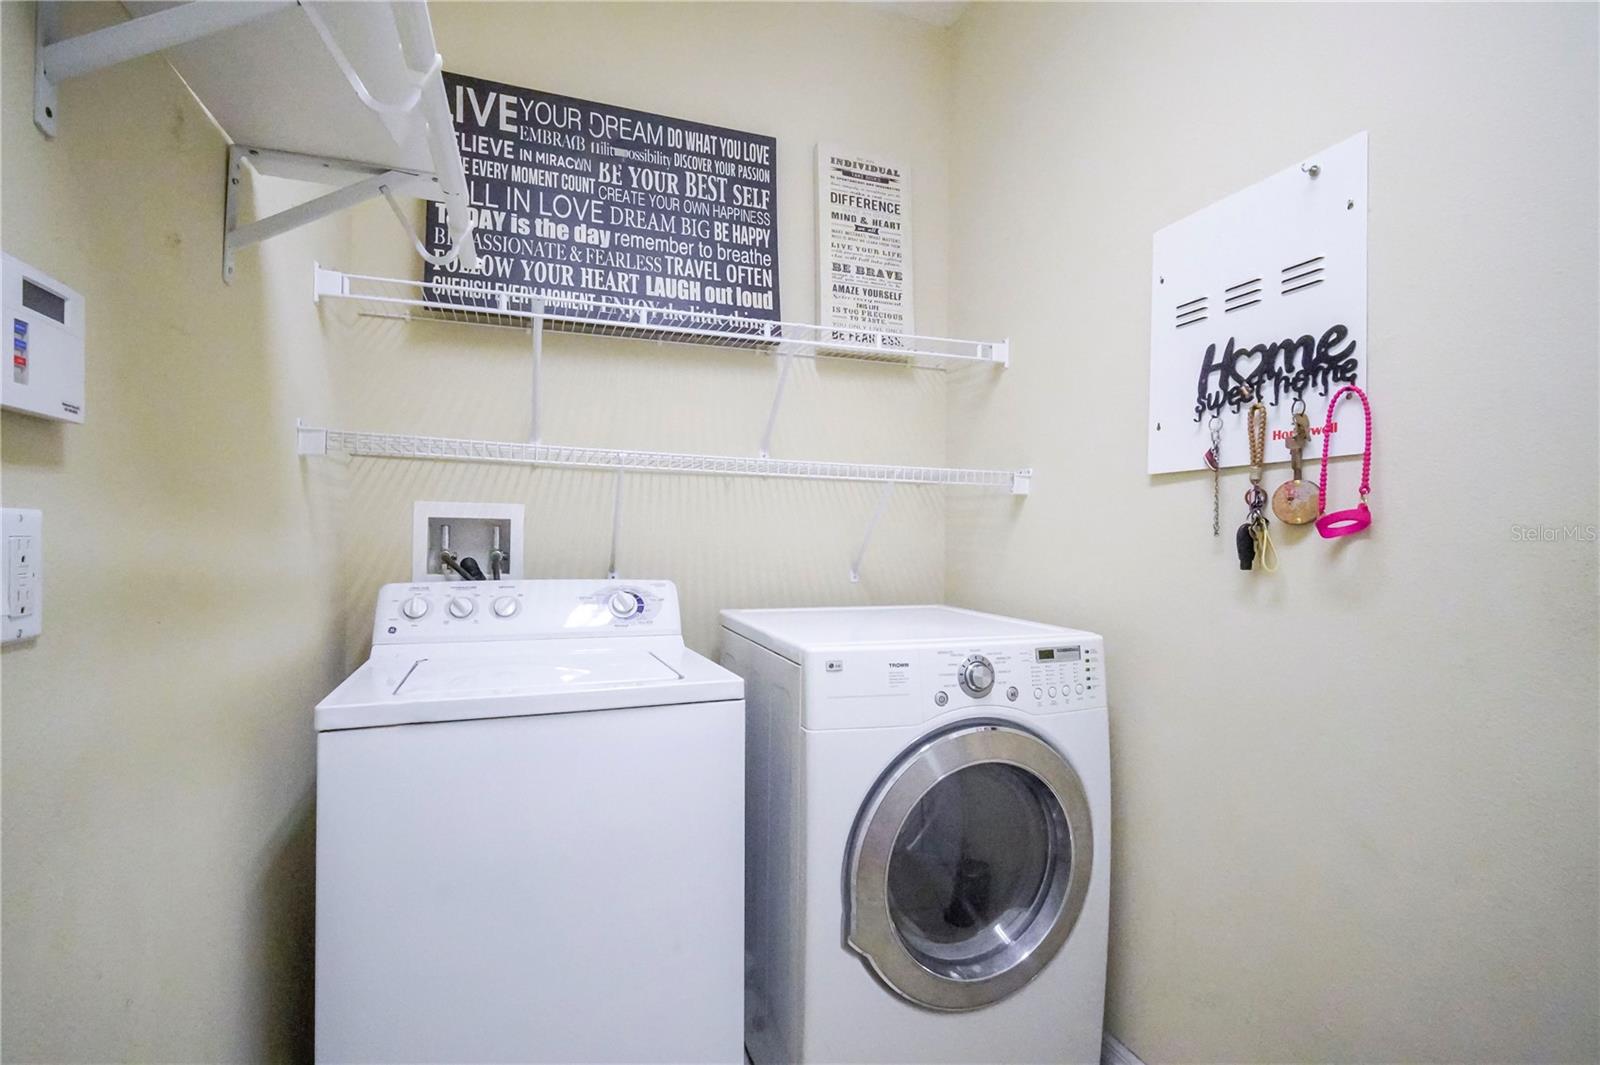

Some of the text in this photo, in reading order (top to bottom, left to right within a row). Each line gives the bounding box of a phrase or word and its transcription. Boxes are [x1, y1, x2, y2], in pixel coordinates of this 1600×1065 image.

[455, 85, 771, 166] IVE YOUR DREAM DO WHAT YOU LOVE
[519, 148, 532, 162] IN
[673, 152, 713, 174] DISCOVER
[714, 159, 736, 178] YOUR
[737, 165, 771, 184] PASSION
[830, 156, 901, 177] INDIVIDUAL
[472, 158, 508, 180] EVERY
[511, 165, 560, 188] MOMENT
[561, 173, 596, 195] COUNT
[598, 162, 771, 210] BE YOUR BEST SELF
[470, 180, 771, 249] LL IN LOVE DREAM BIG BE HAPPY
[598, 186, 771, 227] CREATE YOUR OWN HAPPINESS
[830, 192, 901, 215] DIFFERENCE
[435, 202, 772, 267] TDAY is the day remember to breathe
[831, 212, 857, 223] MIND
[860, 217, 869, 225] &
[872, 219, 901, 231] HEART
[473, 232, 568, 262] ASSIONATE
[569, 246, 584, 263] &
[586, 247, 663, 274] FEARLESS
[664, 255, 722, 282] TRAVEL
[725, 263, 773, 288] OFTEN
[831, 242, 853, 251] LIVE
[855, 246, 880, 256] YOUR
[882, 250, 902, 259] LIFE
[520, 259, 575, 287] YOUR
[580, 266, 640, 295] HEART
[645, 274, 701, 302] LAUGH
[704, 285, 733, 306] out
[736, 287, 774, 310] loud
[832, 262, 851, 273] BE
[855, 265, 903, 281] BRAVE
[540, 288, 596, 312] MOMENT
[832, 284, 860, 296] AMAZE
[862, 287, 903, 301] YOURSELF
[856, 302, 868, 310] THIS
[843, 307, 859, 316] TOO
[861, 310, 903, 322] PRECIOUS
[1198, 324, 1357, 400] Home
